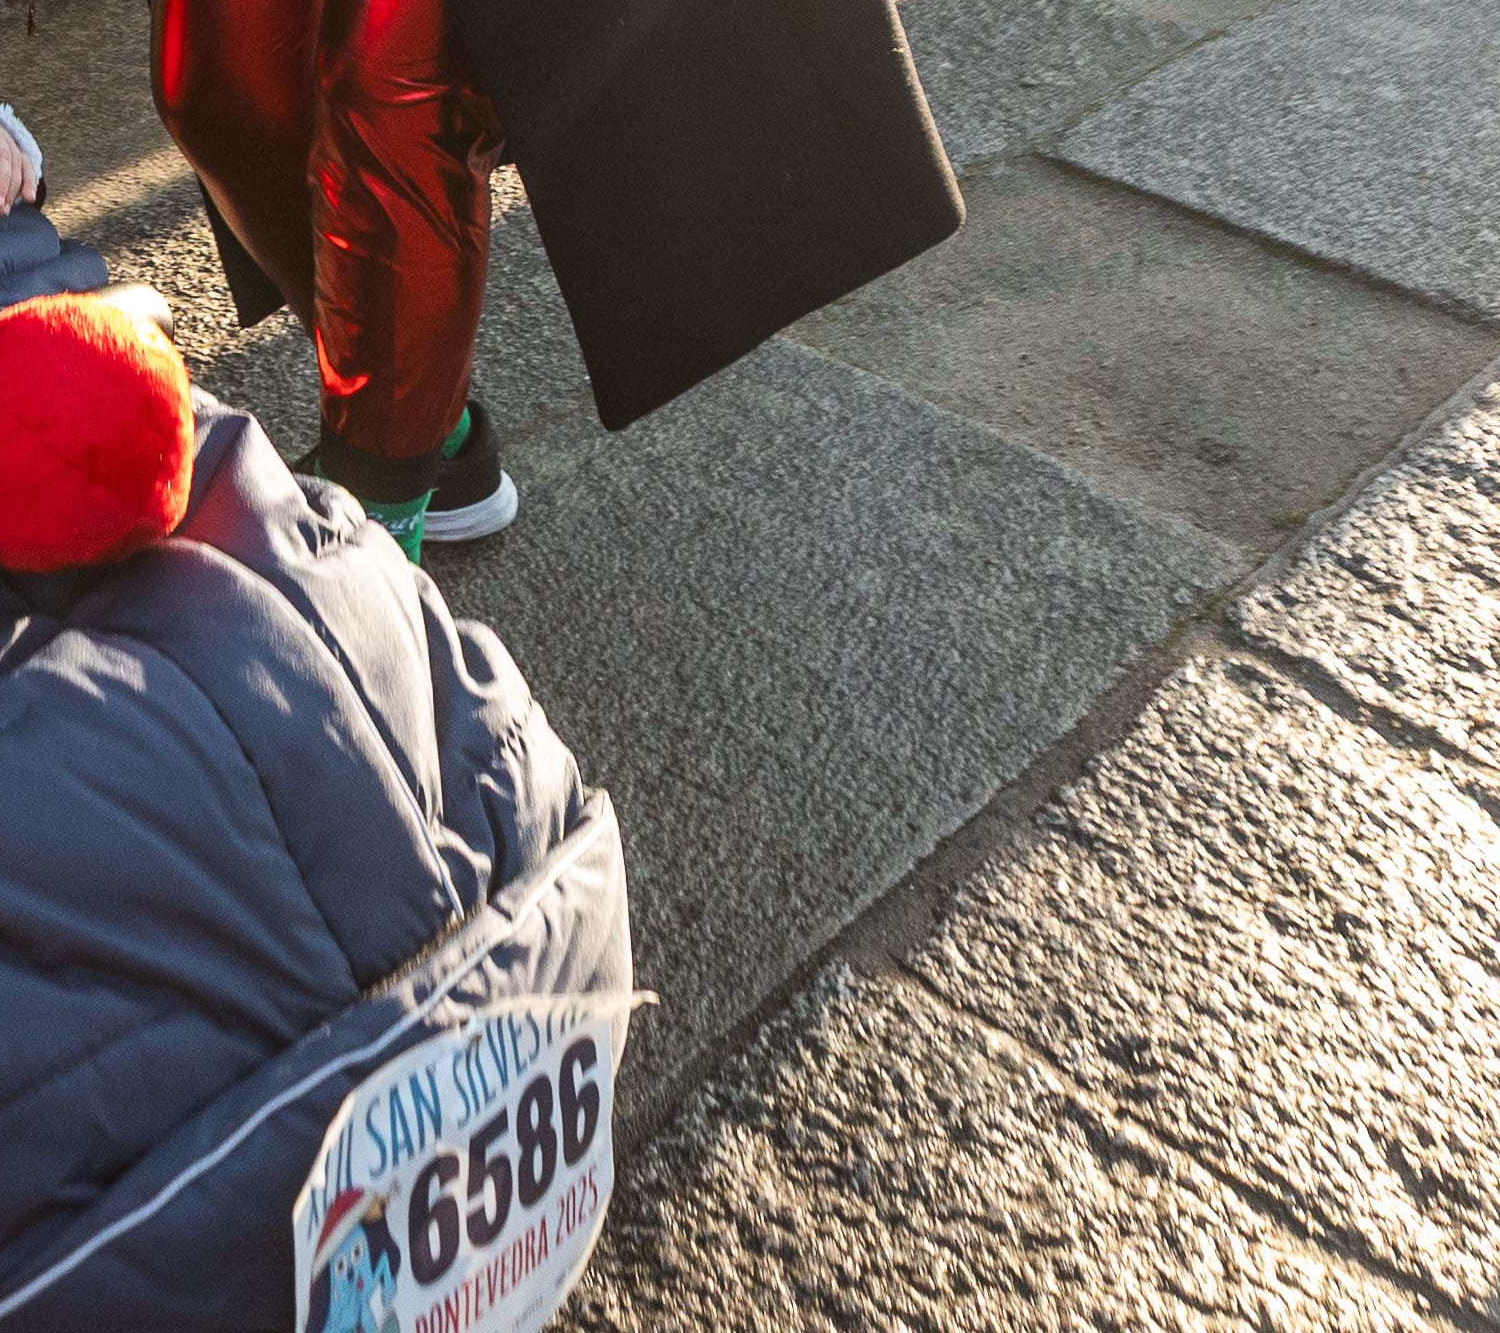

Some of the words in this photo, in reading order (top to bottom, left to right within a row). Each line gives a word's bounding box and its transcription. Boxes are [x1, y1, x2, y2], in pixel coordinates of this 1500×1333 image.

[365, 1065, 443, 1179] SAN
[409, 1036, 600, 1287] 6586
[556, 1163, 599, 1247] 2025
